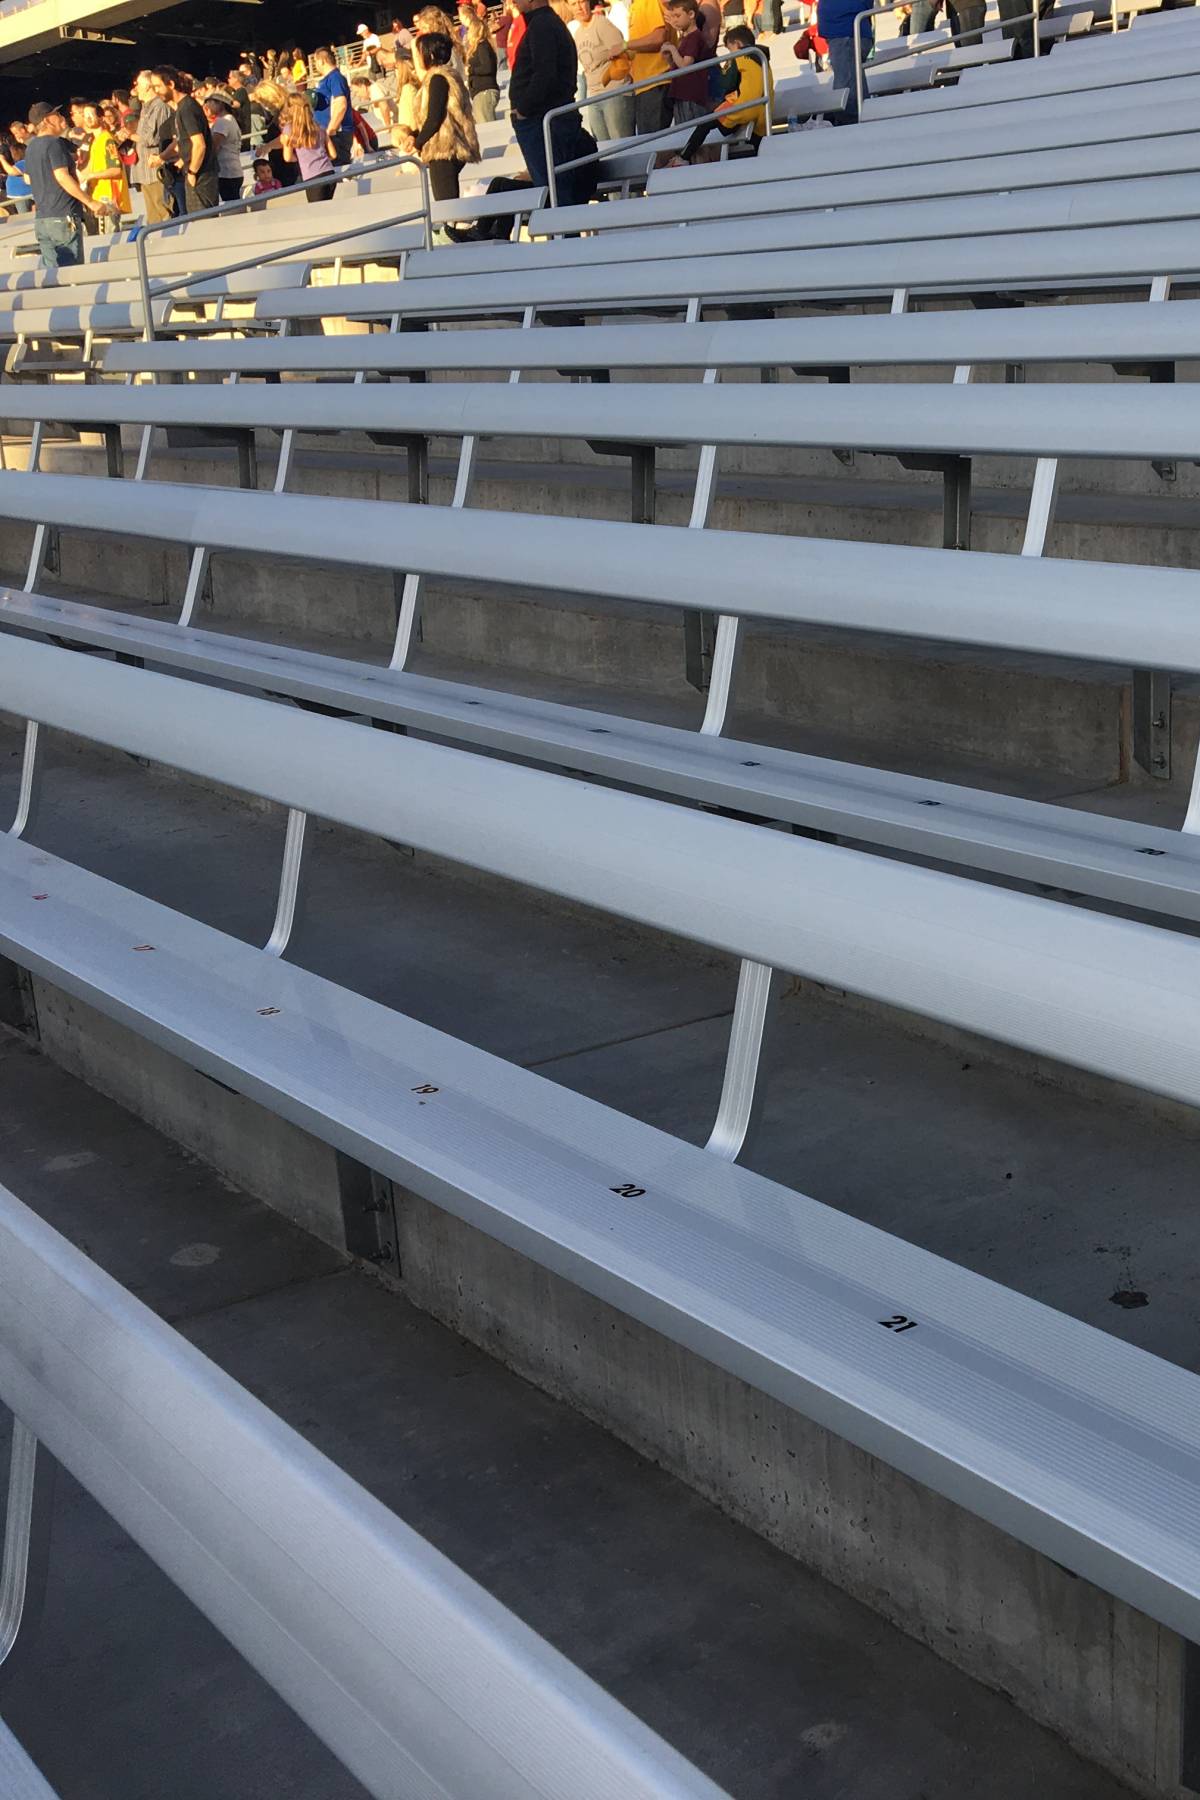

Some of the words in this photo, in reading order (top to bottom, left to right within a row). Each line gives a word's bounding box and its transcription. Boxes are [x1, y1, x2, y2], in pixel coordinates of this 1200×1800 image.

[1133, 847, 1168, 856] 20
[256, 1006, 281, 1016] 18
[410, 1083, 439, 1095] 19
[608, 1183, 647, 1198] 20
[877, 1315, 917, 1333] 21
